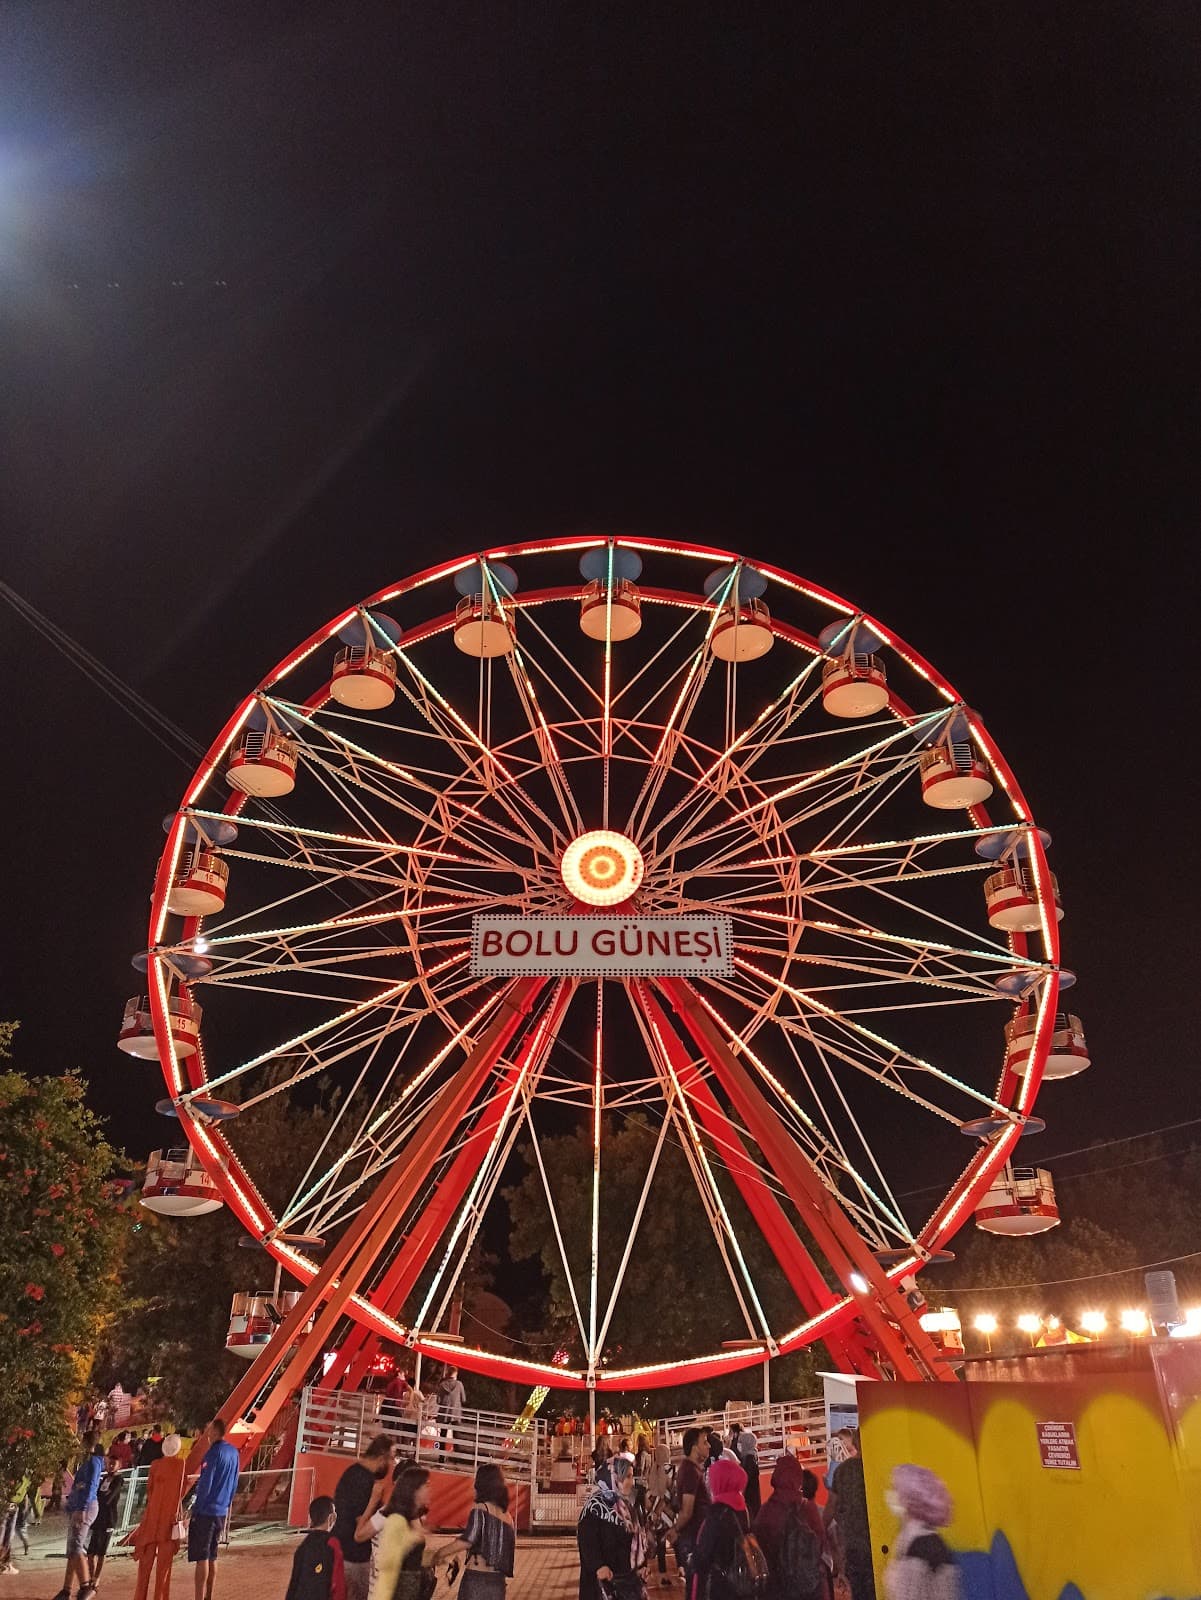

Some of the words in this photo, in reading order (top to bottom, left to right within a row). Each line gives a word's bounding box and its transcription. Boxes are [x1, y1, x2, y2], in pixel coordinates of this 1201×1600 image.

[482, 929, 578, 957] BOLU
[591, 924, 722, 964] GÜNEŞİ
[177, 1018, 186, 1030] 15
